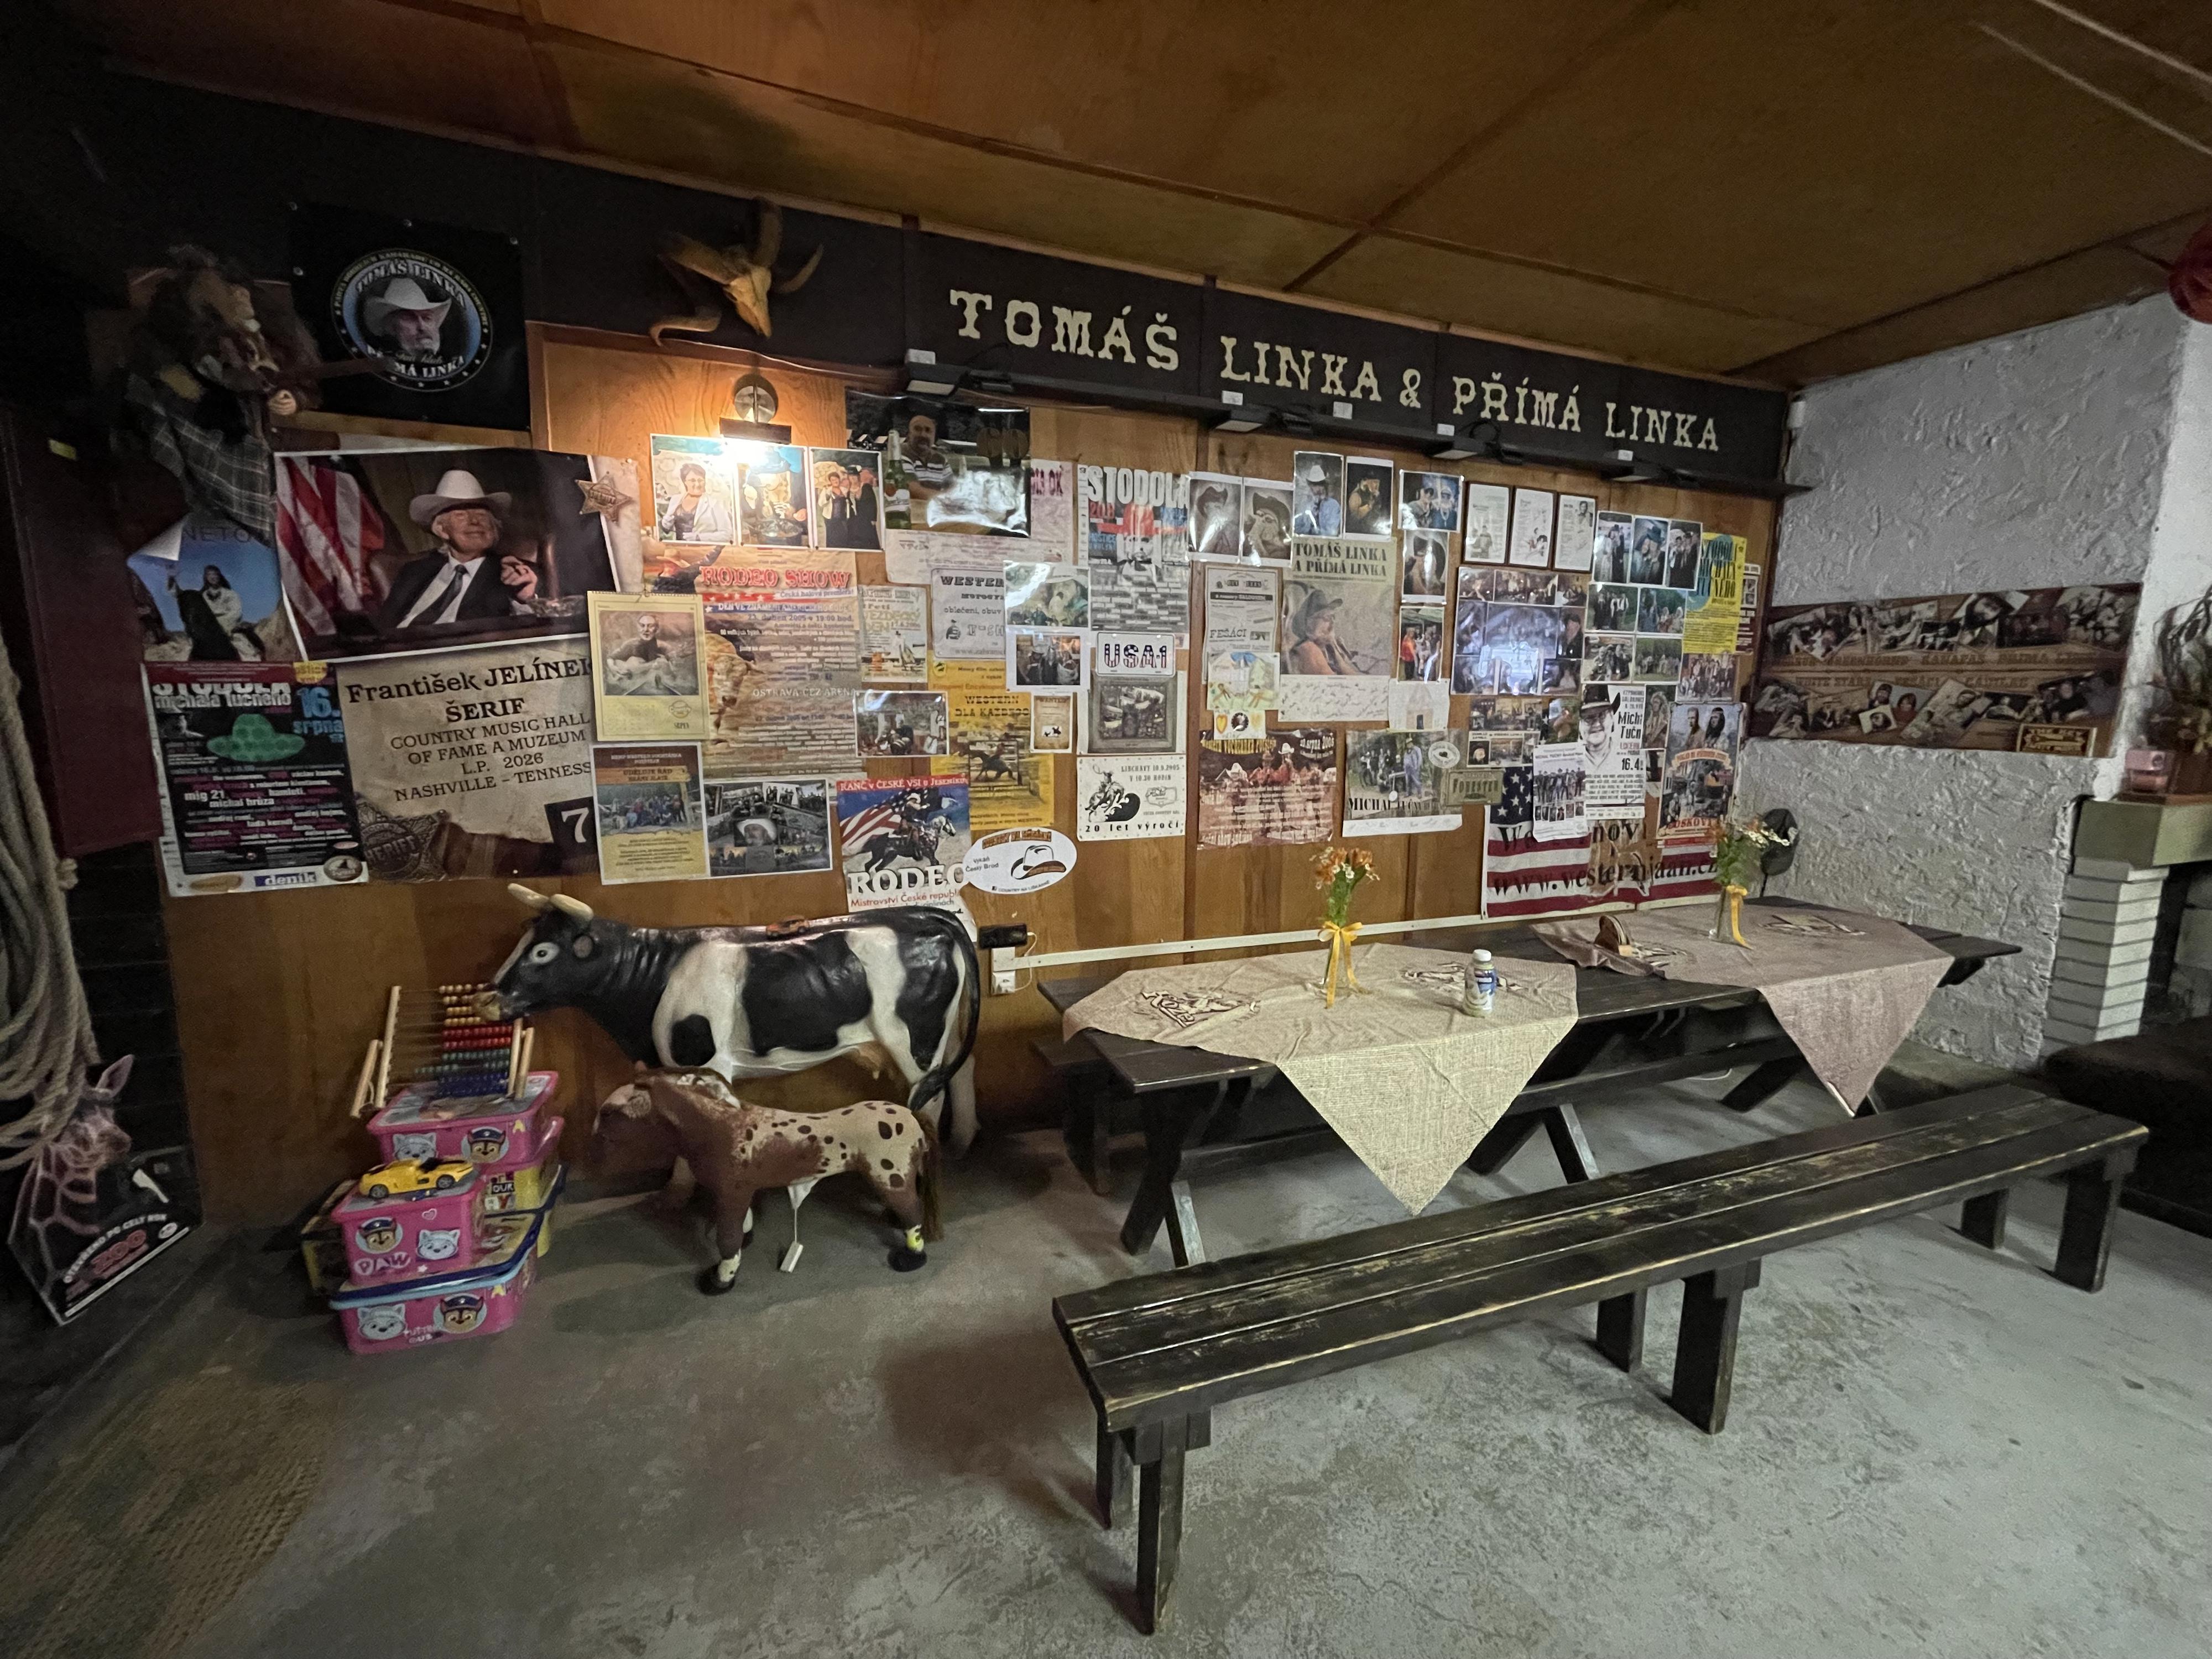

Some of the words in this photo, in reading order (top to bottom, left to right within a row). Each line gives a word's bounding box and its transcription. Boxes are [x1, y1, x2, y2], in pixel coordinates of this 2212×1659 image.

[950, 289, 1179, 371] TOMÁŠ
[1220, 336, 1382, 401] LINKA
[1400, 368, 1421, 409] &
[1452, 372, 1581, 432] PŘÍMÁ
[1605, 402, 1718, 451] LINKA
[1294, 542, 1341, 559] TOMÁŠ
[1345, 546, 1386, 561] LINKA
[700, 566, 779, 587] RODEO
[785, 569, 851, 588] SHOW
[1293, 560, 1301, 572] A
[1306, 558, 1346, 574] PŘÍMÁ
[1350, 562, 1386, 576] LINKA
[1210, 628, 1247, 638] FEŠÁCI
[345, 672, 481, 703] František
[753, 688, 799, 697] OSTRAVA
[297, 686, 341, 718] 16.
[445, 697, 525, 722] ŠERIF
[965, 696, 1019, 704] WESTERN
[293, 719, 344, 735] srpna
[391, 727, 476, 749] COUNTRY
[482, 719, 540, 737] MUSIC
[545, 713, 590, 729] HALL
[408, 750, 433, 764] OF
[439, 743, 487, 760] FAME
[493, 740, 505, 753] A
[508, 729, 586, 751] MUZEUM
[461, 761, 491, 775] L.P.
[504, 752, 544, 769] 2026
[394, 776, 497, 801] NASHVILLE
[876, 779, 905, 789] ČESKÉ
[184, 791, 208, 801] mig
[209, 798, 244, 808] michal
[246, 796, 275, 806] hrůza
[561, 807, 589, 843] 7
[1110, 823, 1129, 832] let
[1138, 820, 1179, 831] výročí
[265, 872, 316, 885] deník
[847, 863, 966, 894] RODEO
[851, 894, 899, 907] Mistrovství
[901, 892, 927, 902] České
[354, 1251, 411, 1275] PAW
